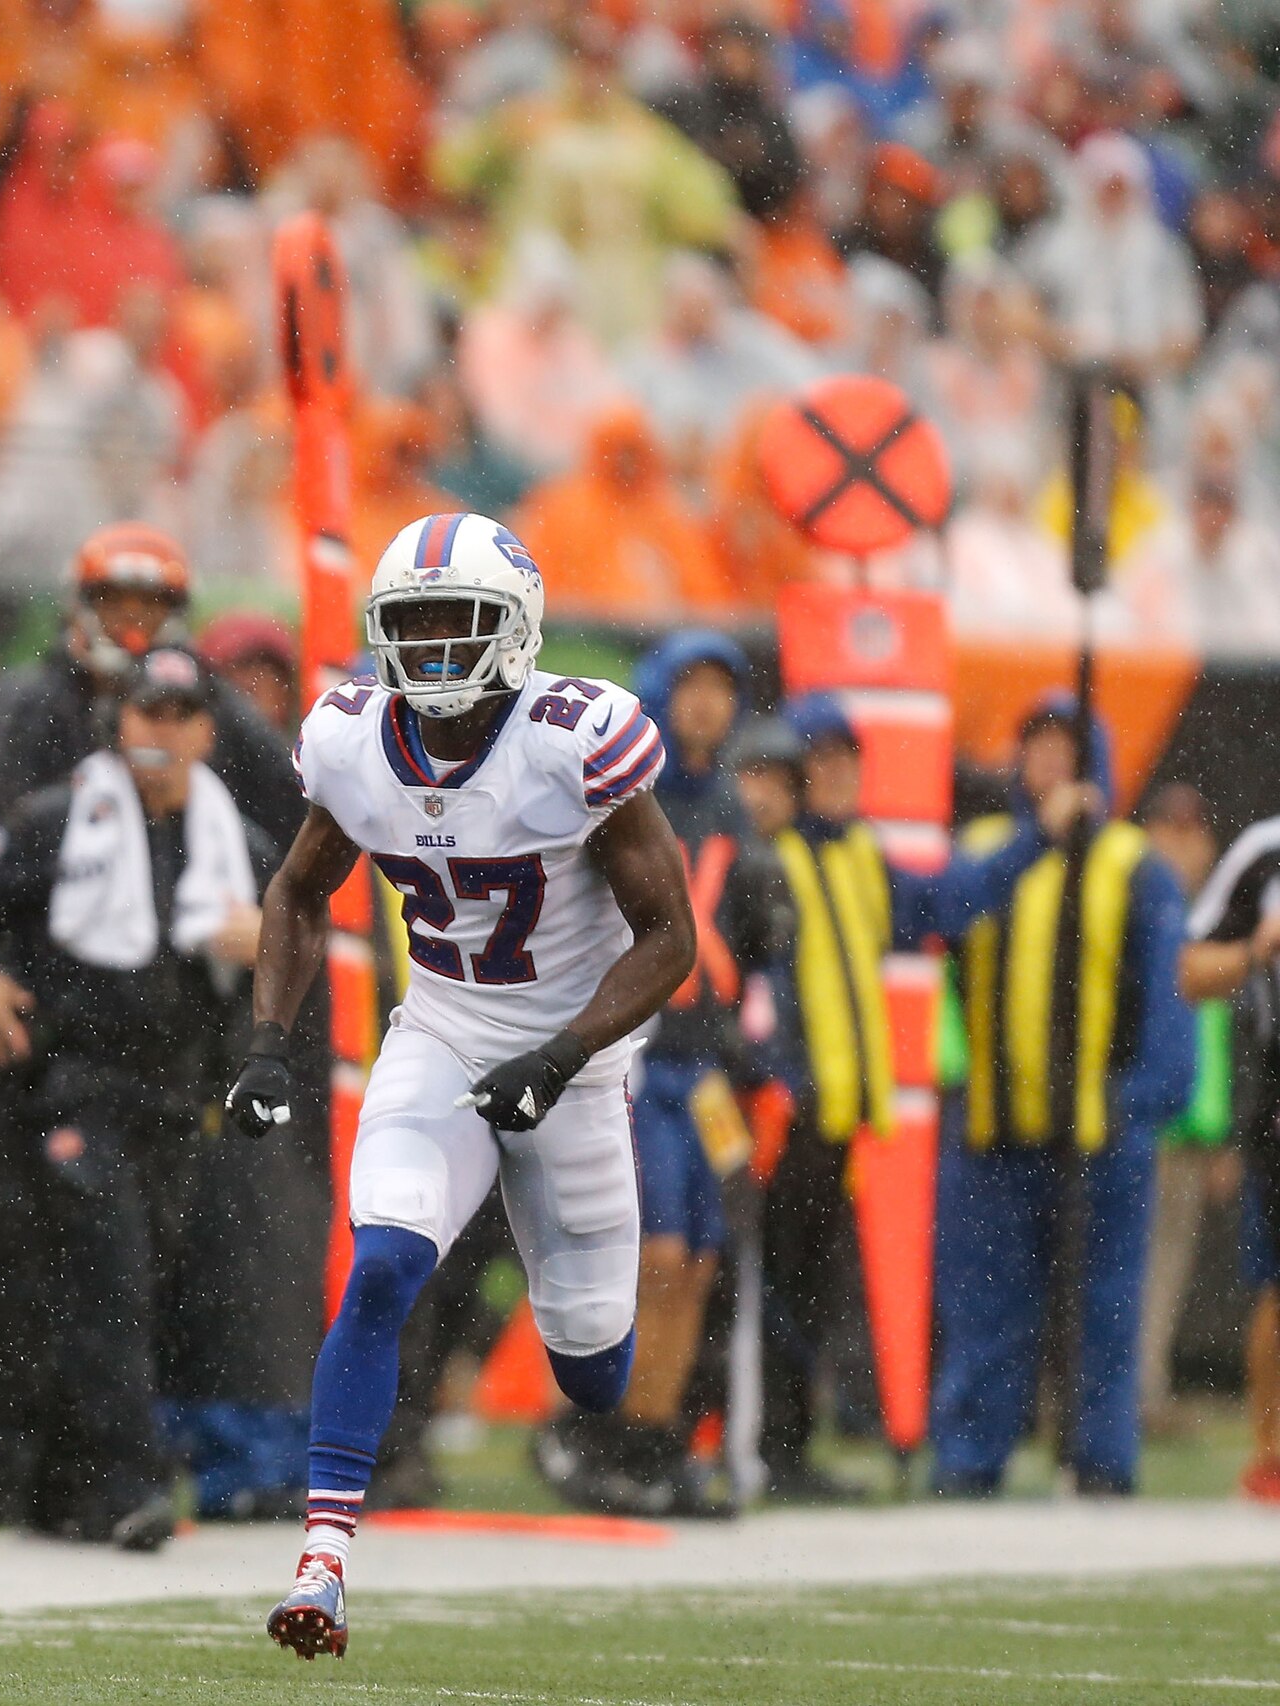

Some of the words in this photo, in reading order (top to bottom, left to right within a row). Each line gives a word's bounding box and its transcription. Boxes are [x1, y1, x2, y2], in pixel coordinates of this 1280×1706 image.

[529, 677, 607, 732] 27
[415, 834, 456, 848] BILLS
[370, 853, 548, 985] 27
